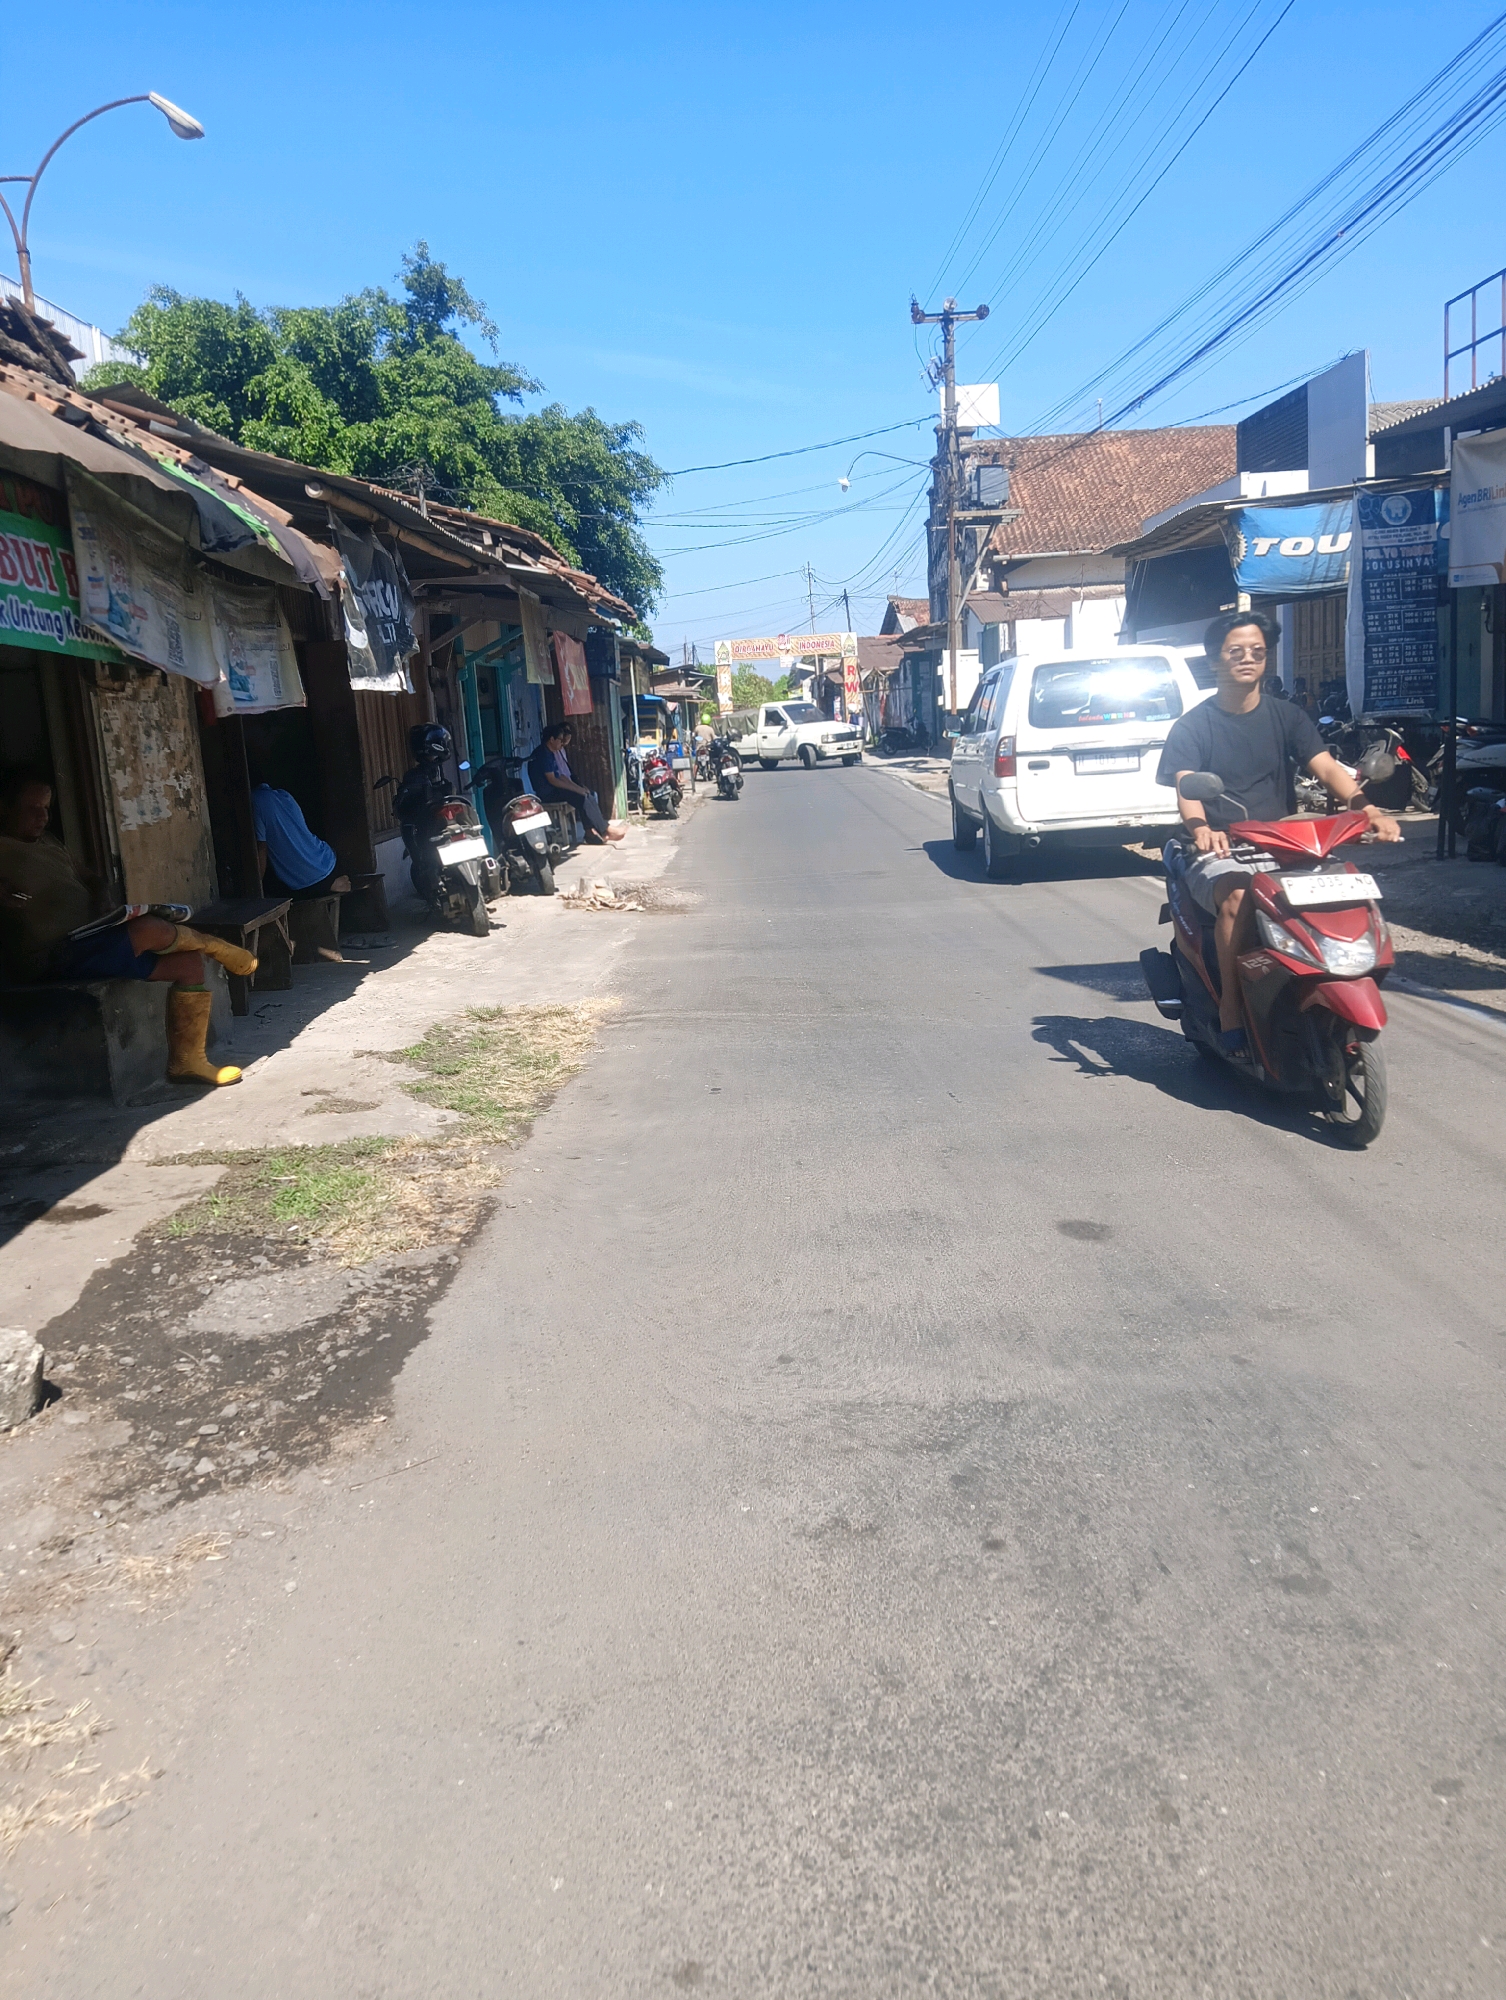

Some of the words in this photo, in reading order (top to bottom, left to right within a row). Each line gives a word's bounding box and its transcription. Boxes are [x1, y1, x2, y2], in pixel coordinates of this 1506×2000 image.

[1457, 484, 1506, 508] AgenBRILin
[1252, 532, 1352, 556] TOU
[10, 597, 64, 643] Untung
[734, 644, 774, 654] DIRGAHAYU
[800, 640, 834, 650] INDONESIA
[1242, 956, 1273, 969] 125
